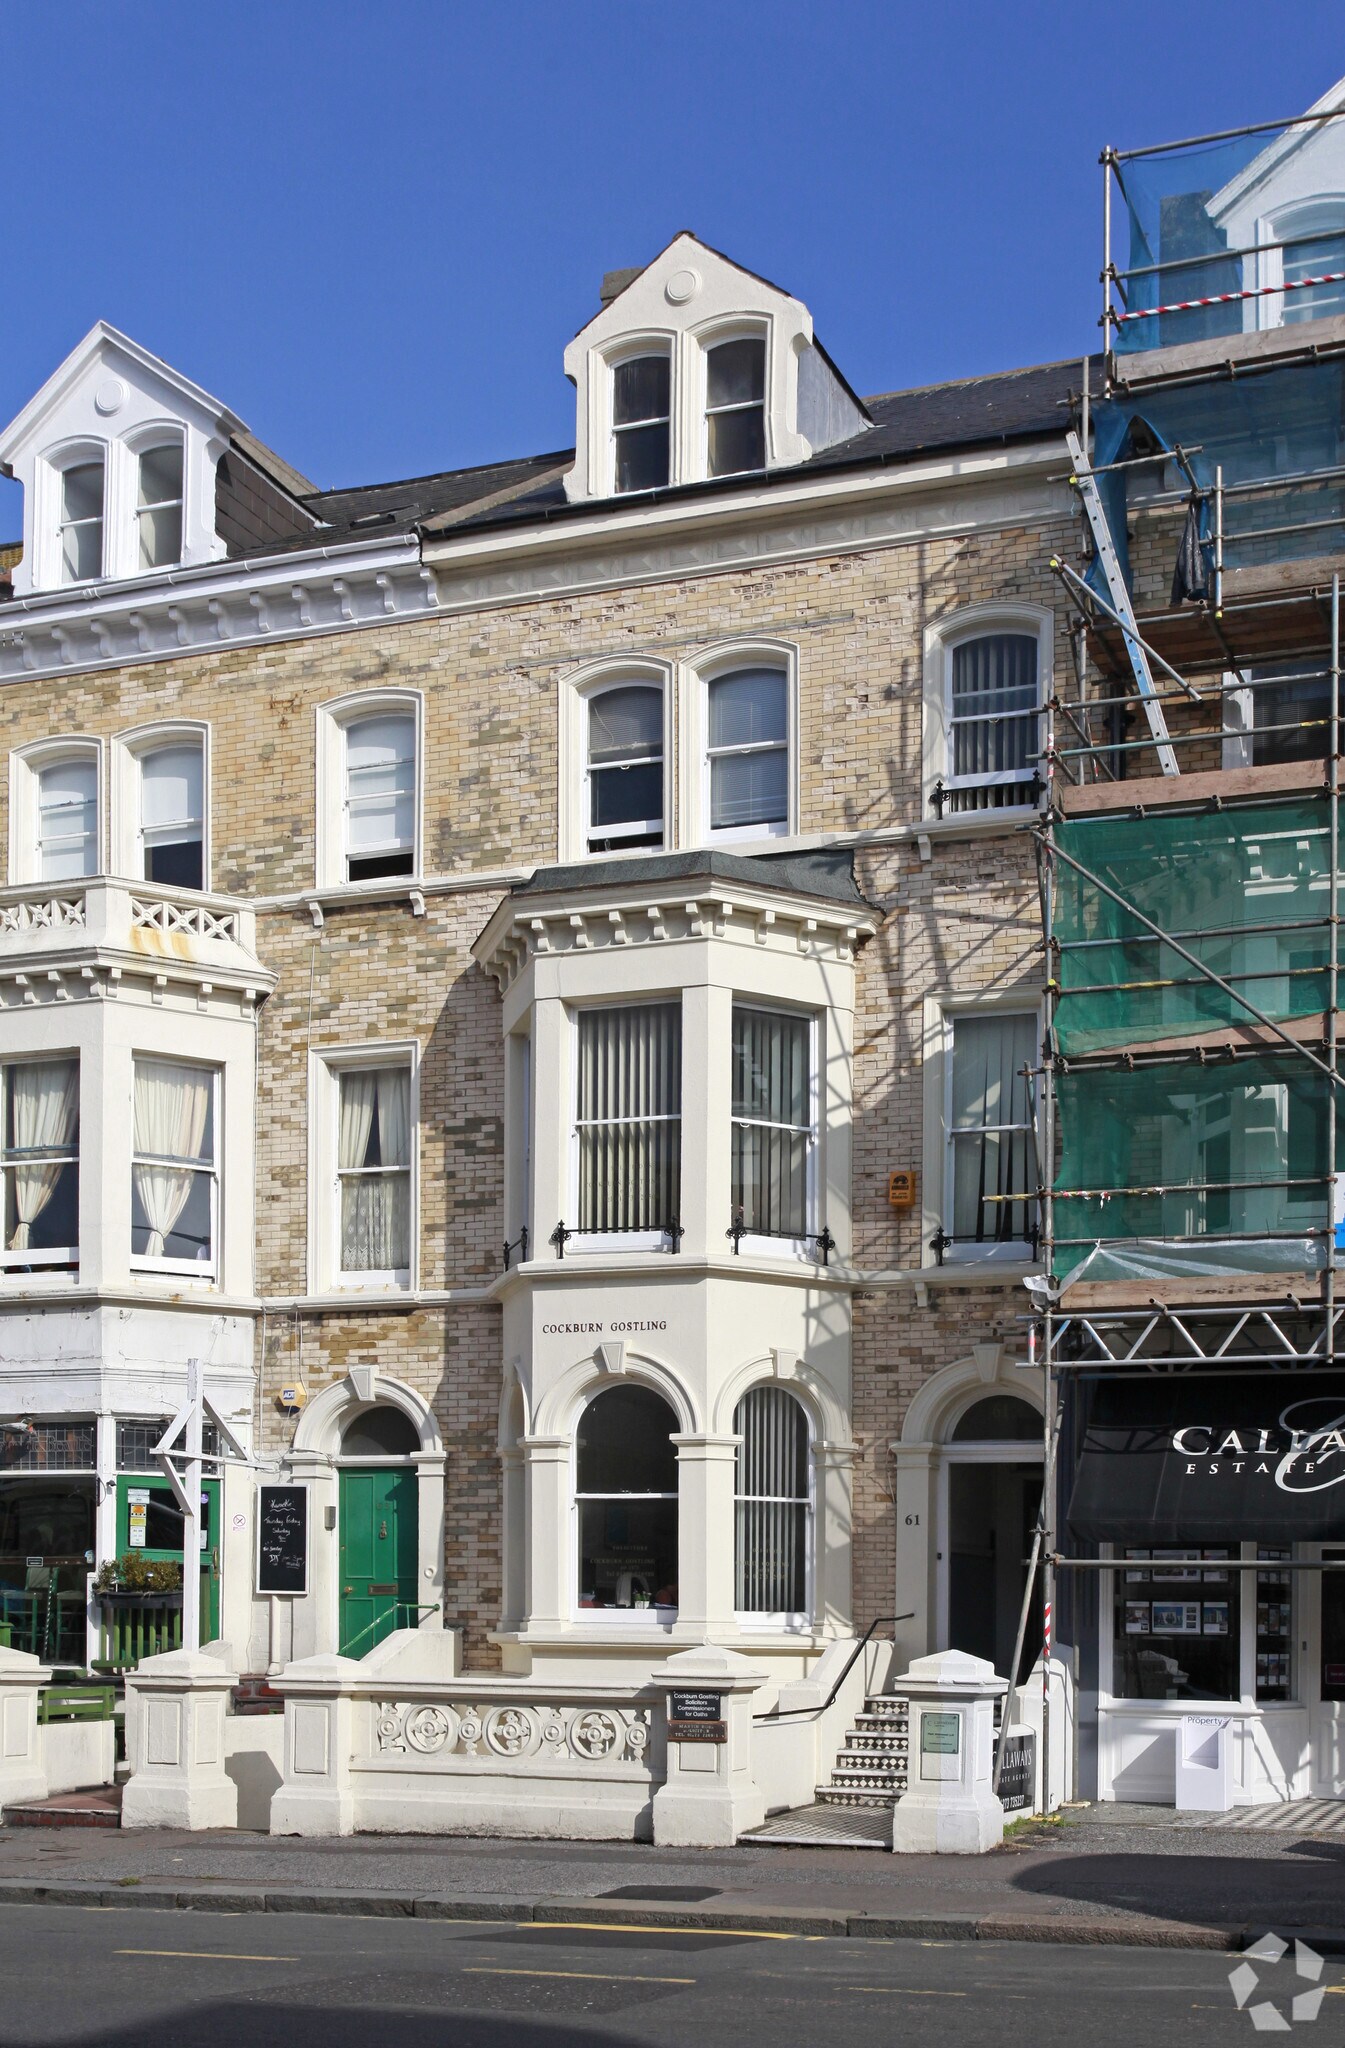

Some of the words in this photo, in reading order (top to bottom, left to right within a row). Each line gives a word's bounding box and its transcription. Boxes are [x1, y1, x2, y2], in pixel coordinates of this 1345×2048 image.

[542, 1322, 603, 1334] COCKBURN
[610, 1320, 667, 1332] GOSTLING
[1185, 1462, 1315, 1475] ESTATE
[905, 1514, 920, 1526] 61
[992, 1749, 1032, 1770] CLLAWAYS
